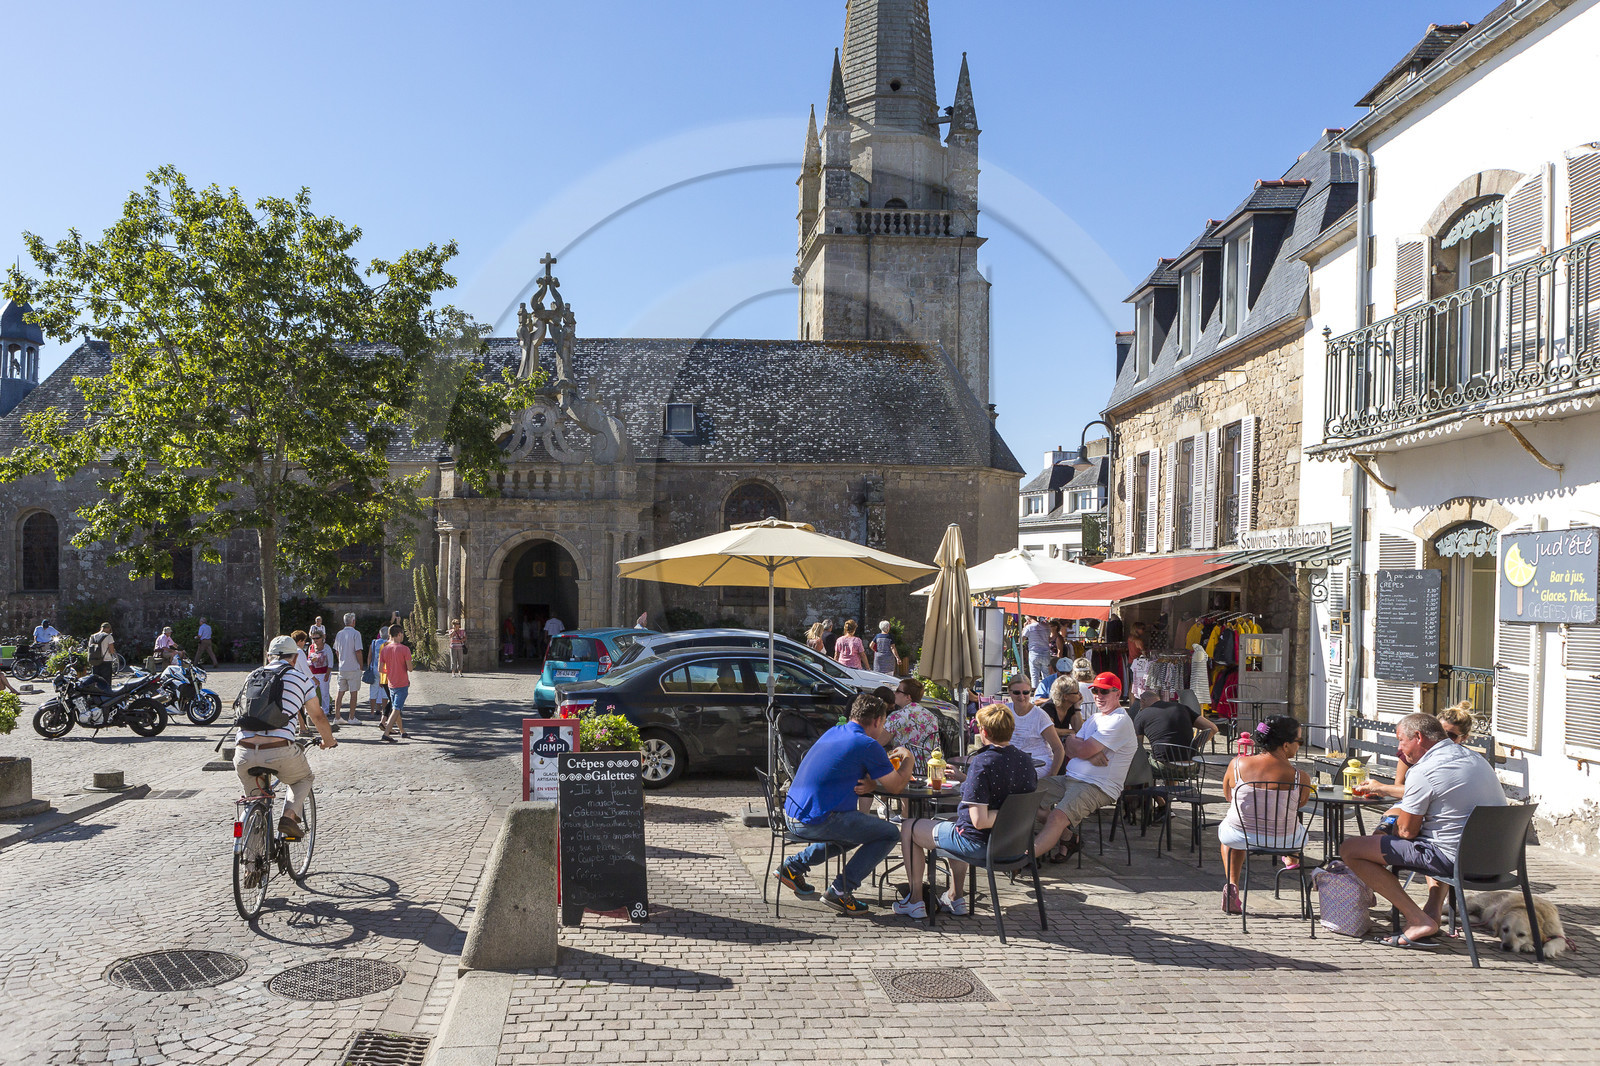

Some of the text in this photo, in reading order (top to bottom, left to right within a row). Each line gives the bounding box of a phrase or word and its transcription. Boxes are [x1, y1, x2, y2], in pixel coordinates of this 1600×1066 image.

[1240, 528, 1326, 550] Souvenirs de Bretagne
[1530, 532, 1593, 566] jud'été
[1550, 570, 1585, 585] Bar à jus,
[1540, 589, 1594, 603] Glaces, Thés...
[537, 744, 565, 752] JAMPI
[567, 758, 604, 770] Crêpes
[592, 770, 635, 781] Galettes
